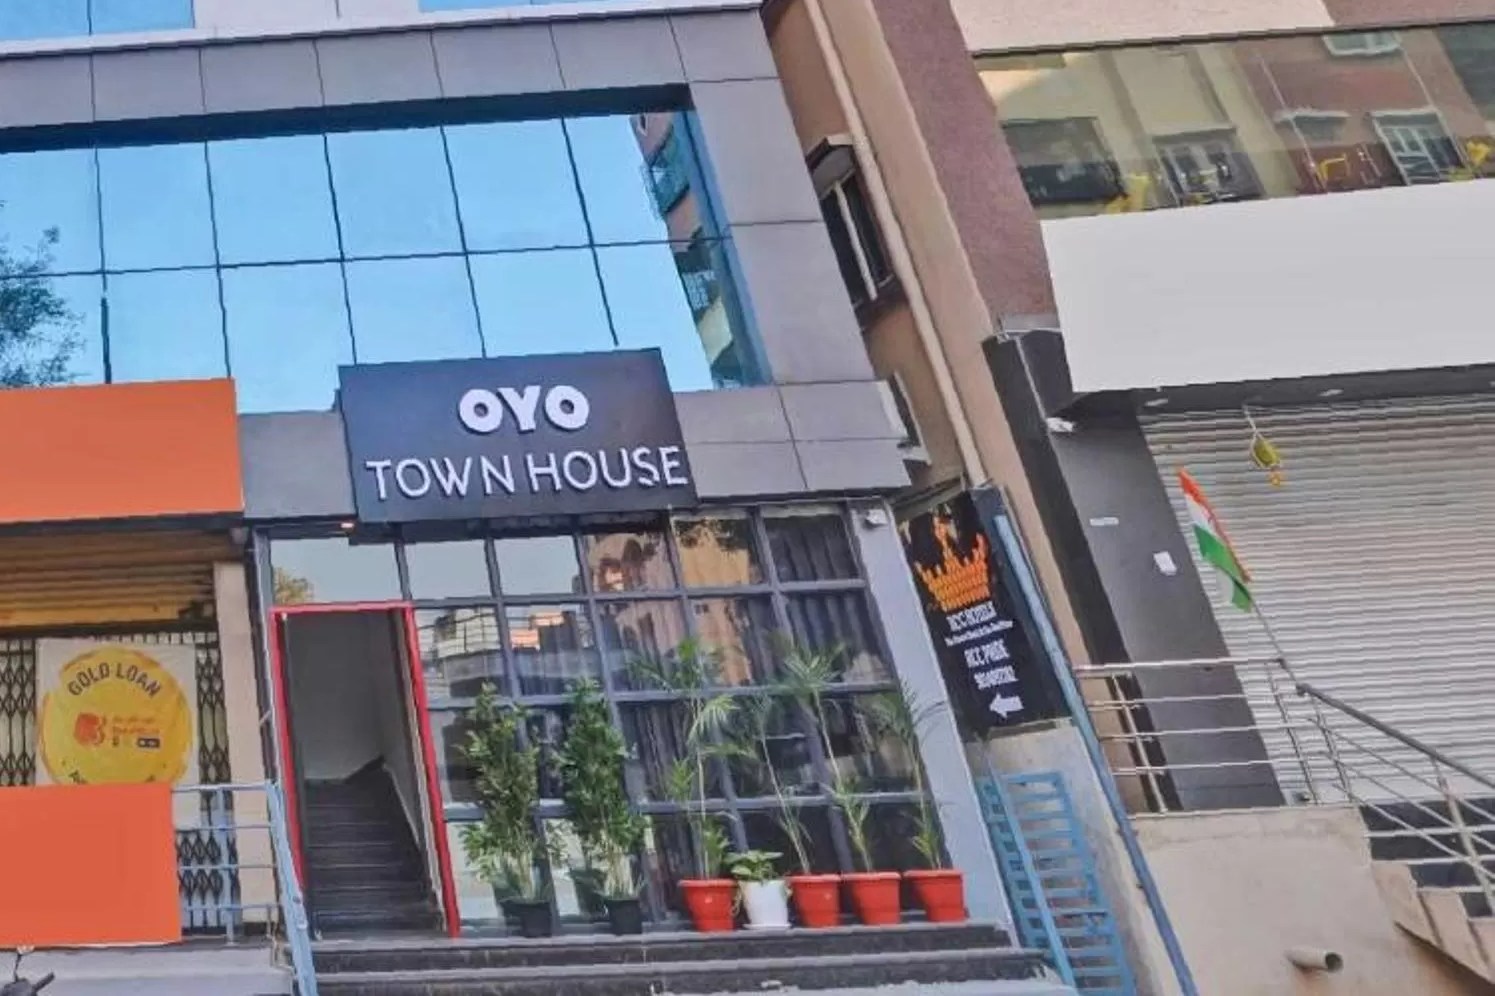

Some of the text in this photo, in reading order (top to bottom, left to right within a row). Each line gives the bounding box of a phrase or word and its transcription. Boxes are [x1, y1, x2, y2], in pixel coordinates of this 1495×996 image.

[457, 384, 590, 433] OYO
[67, 661, 162, 697] GOLD LOAN
